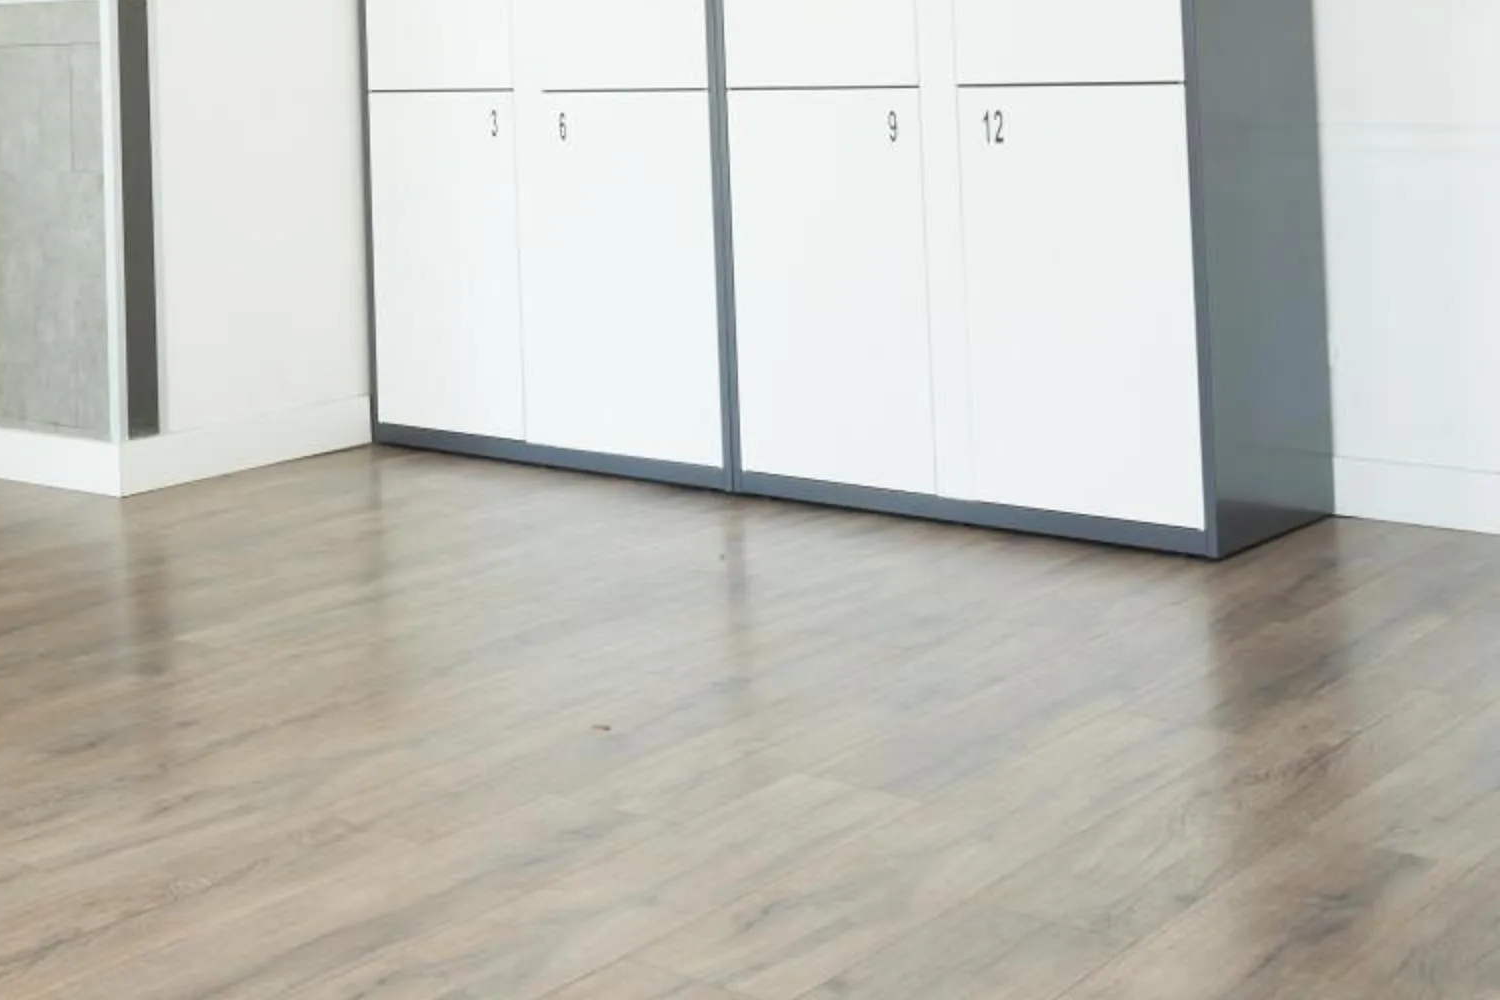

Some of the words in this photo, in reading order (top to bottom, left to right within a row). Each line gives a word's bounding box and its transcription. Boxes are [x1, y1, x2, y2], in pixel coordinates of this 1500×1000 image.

[490, 108, 499, 138] 3
[558, 111, 568, 142] 6
[886, 109, 899, 144] 9
[981, 108, 1006, 145] 12
